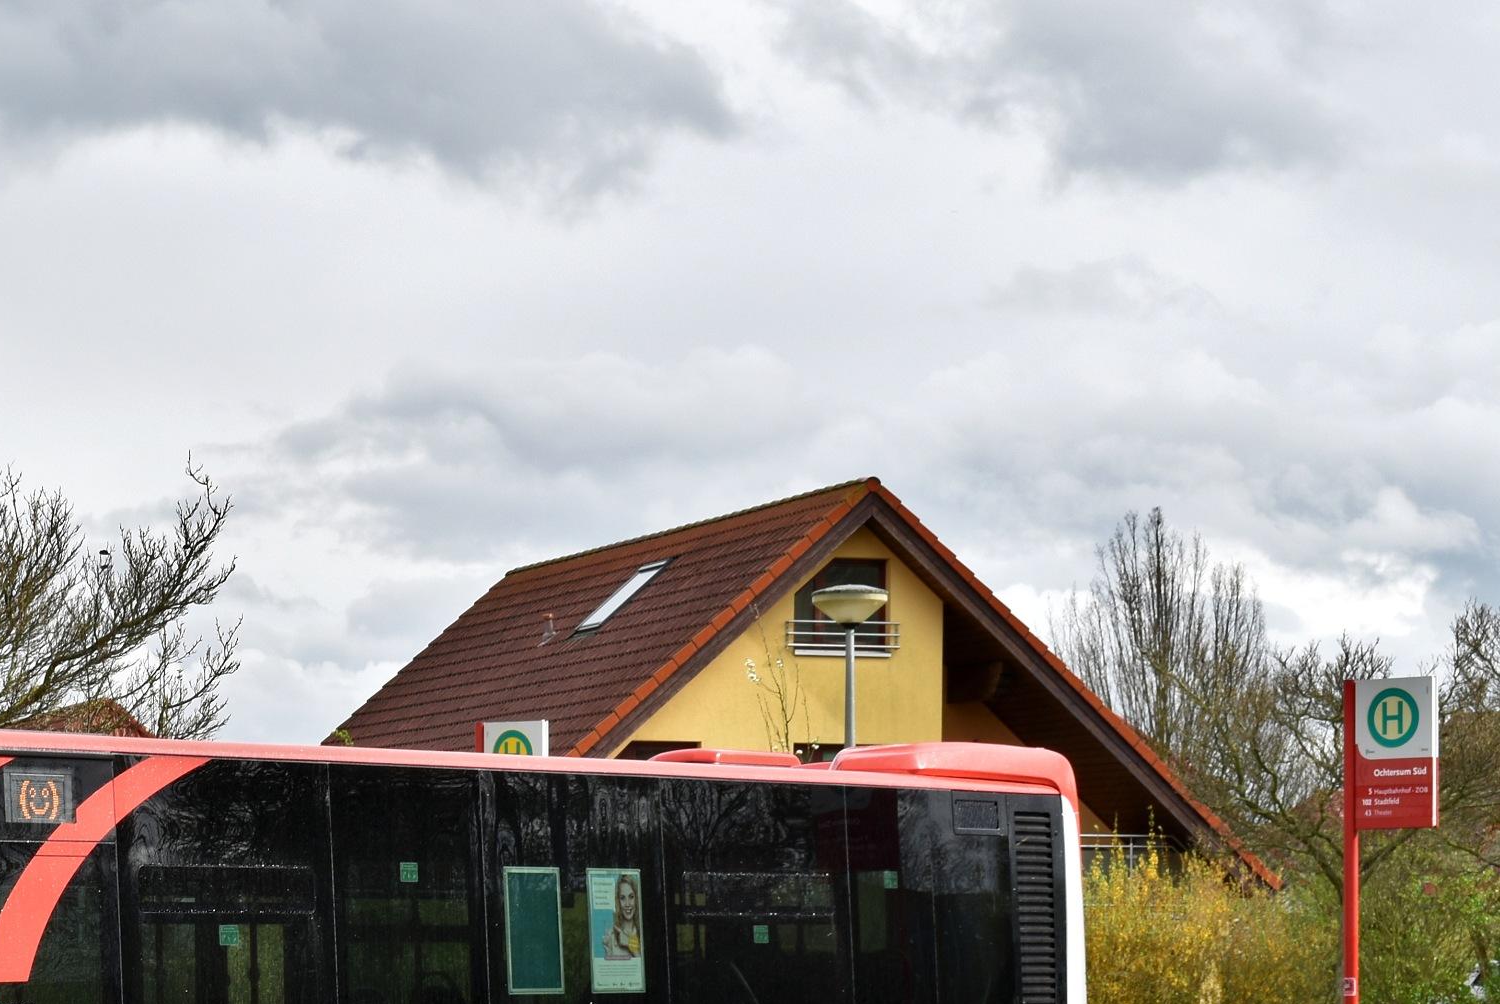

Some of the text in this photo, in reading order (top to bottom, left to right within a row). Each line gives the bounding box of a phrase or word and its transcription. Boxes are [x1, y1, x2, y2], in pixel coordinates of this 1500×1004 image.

[1382, 700, 1403, 736] H
[1373, 766, 1427, 777] Ochtersum Süd
[1374, 797, 1400, 806] Stadtfeld
